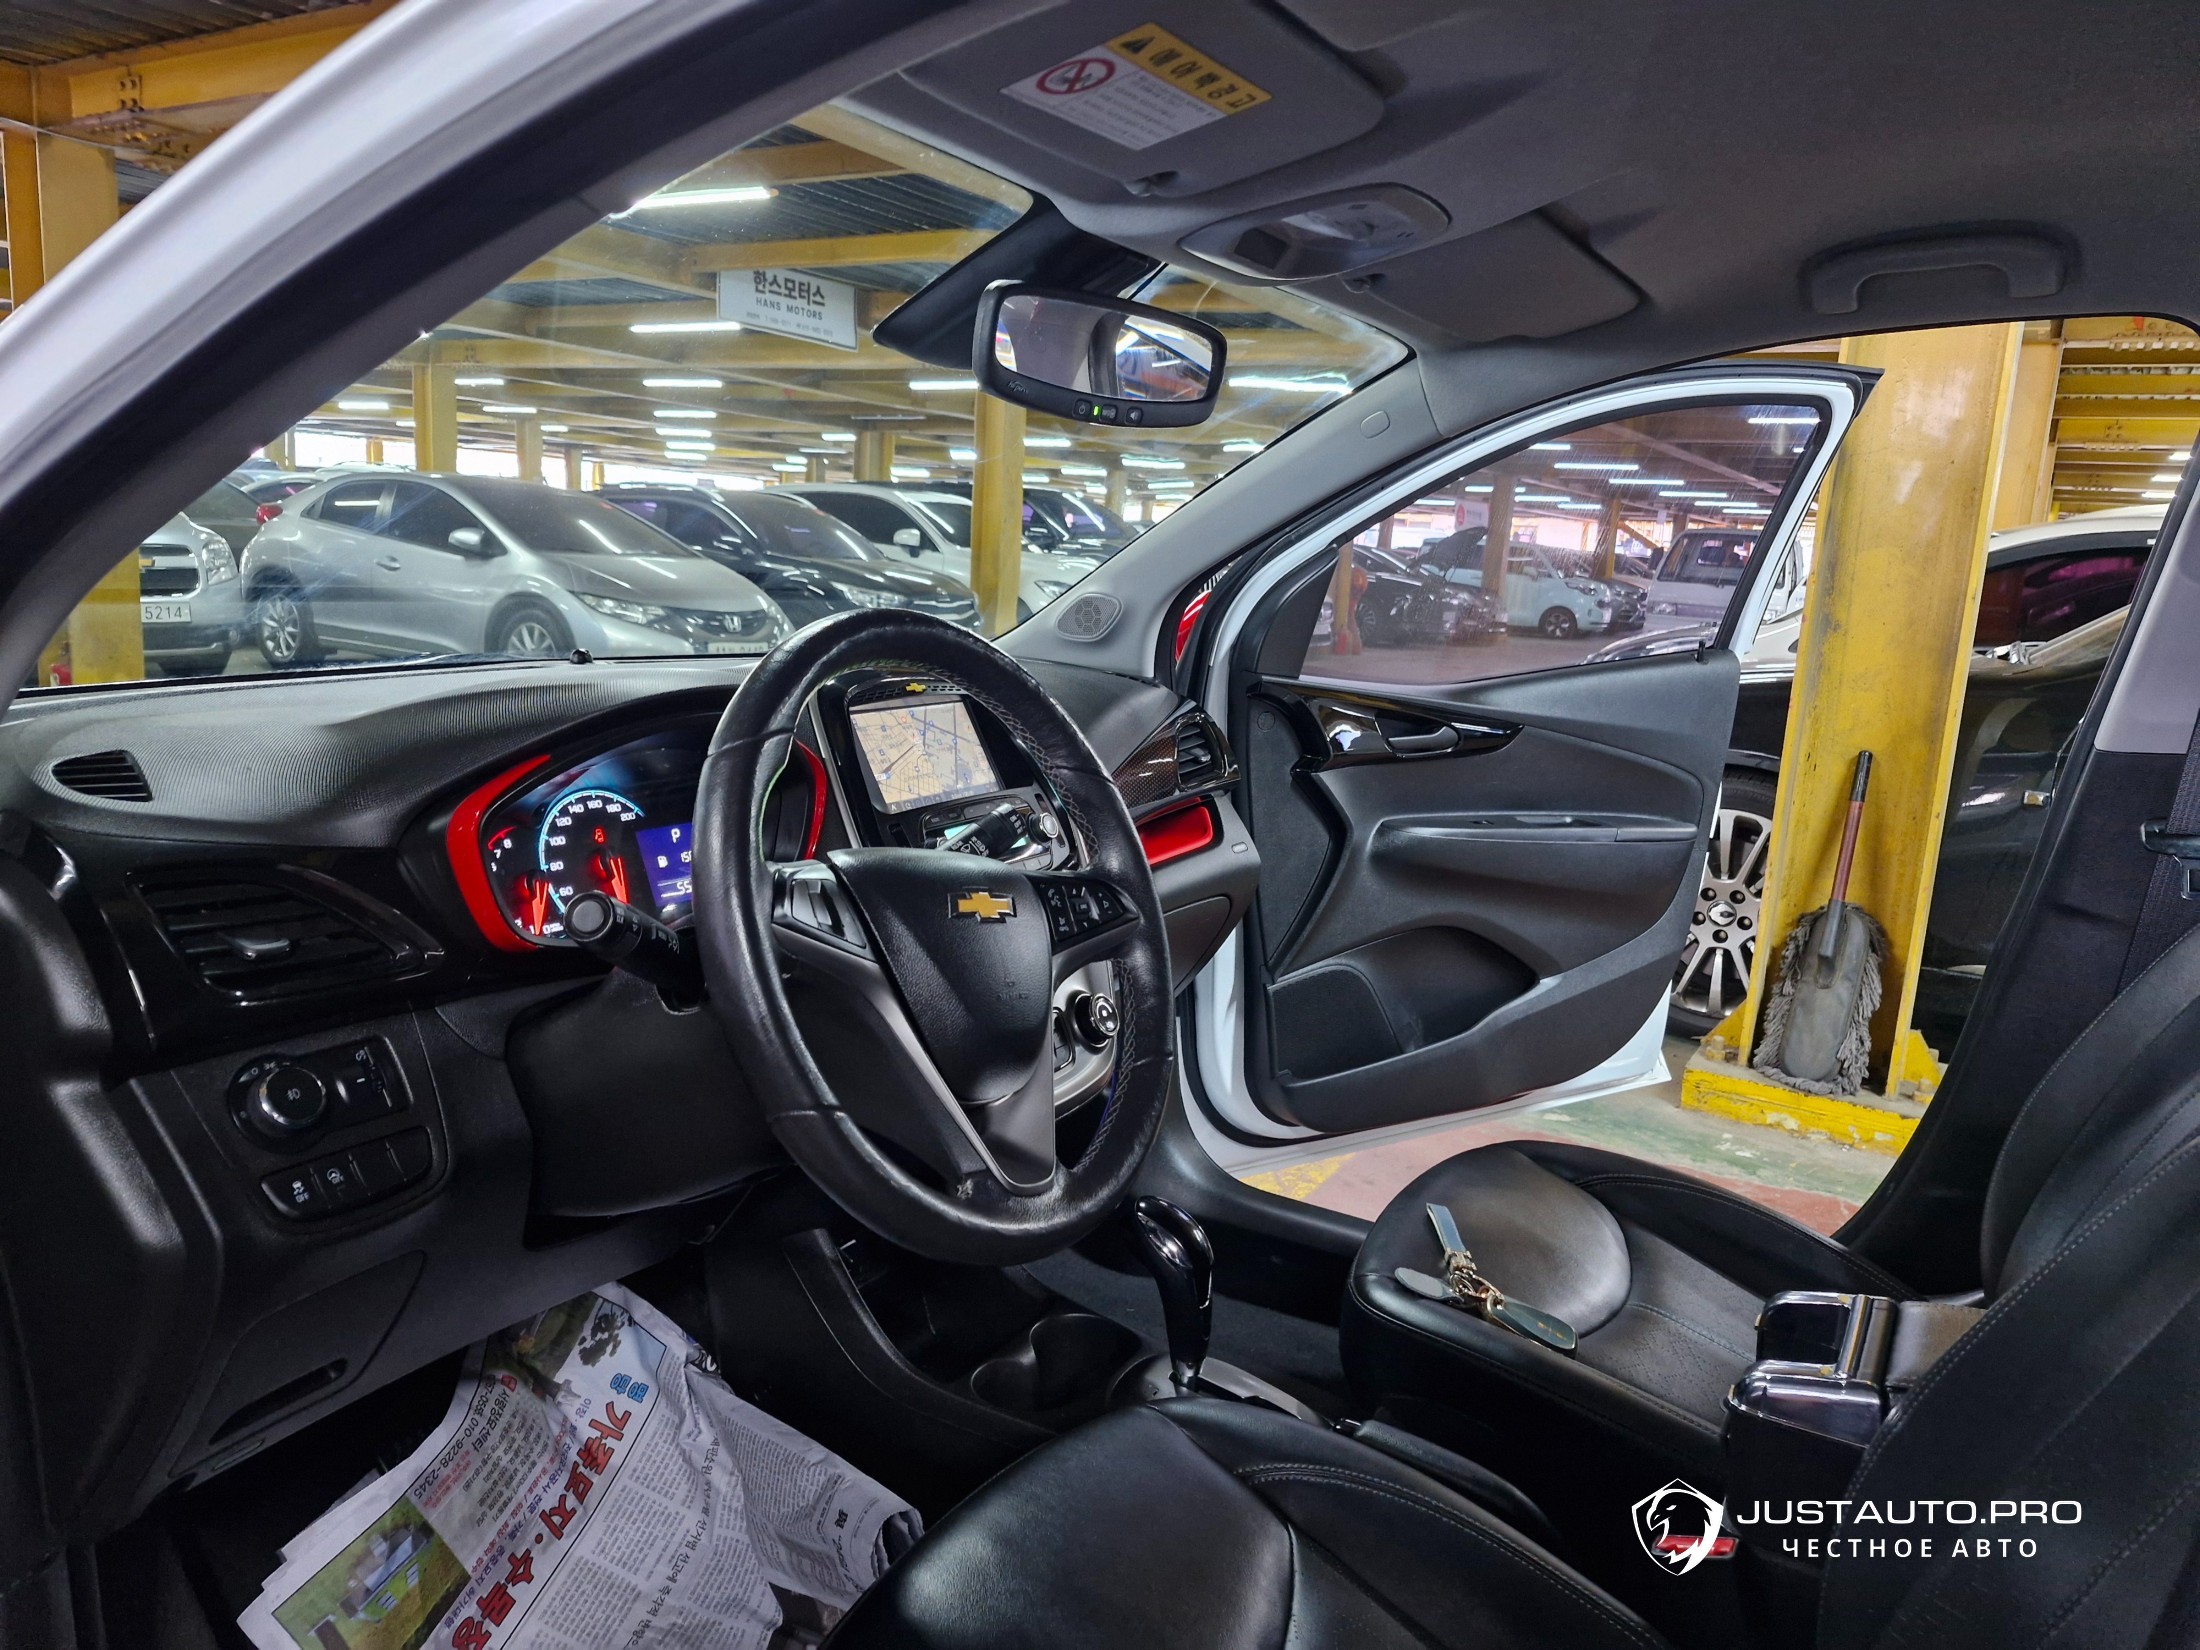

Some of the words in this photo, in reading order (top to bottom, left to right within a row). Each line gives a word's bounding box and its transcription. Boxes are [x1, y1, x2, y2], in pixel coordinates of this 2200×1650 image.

[753, 270, 826, 307] 한스모터스
[756, 297, 781, 311] HANS
[786, 305, 823, 321] MOTORS
[145, 605, 182, 620] 5214
[568, 803, 584, 814] 140
[587, 799, 603, 810] 160
[606, 803, 622, 813] 180
[556, 817, 572, 827] 120
[620, 812, 636, 822] 200
[549, 836, 566, 846] 100
[671, 828, 681, 843] P
[550, 862, 564, 871] 80
[559, 886, 573, 896] 60
[295, 1192, 309, 1203] OFF
[609, 1371, 650, 1404] 명당
[412, 1418, 478, 1499] 010-9228-2345
[684, 1519, 708, 1551] 선거법
[666, 1550, 691, 1584] 선고에
[646, 1583, 672, 1617] 즉각적
